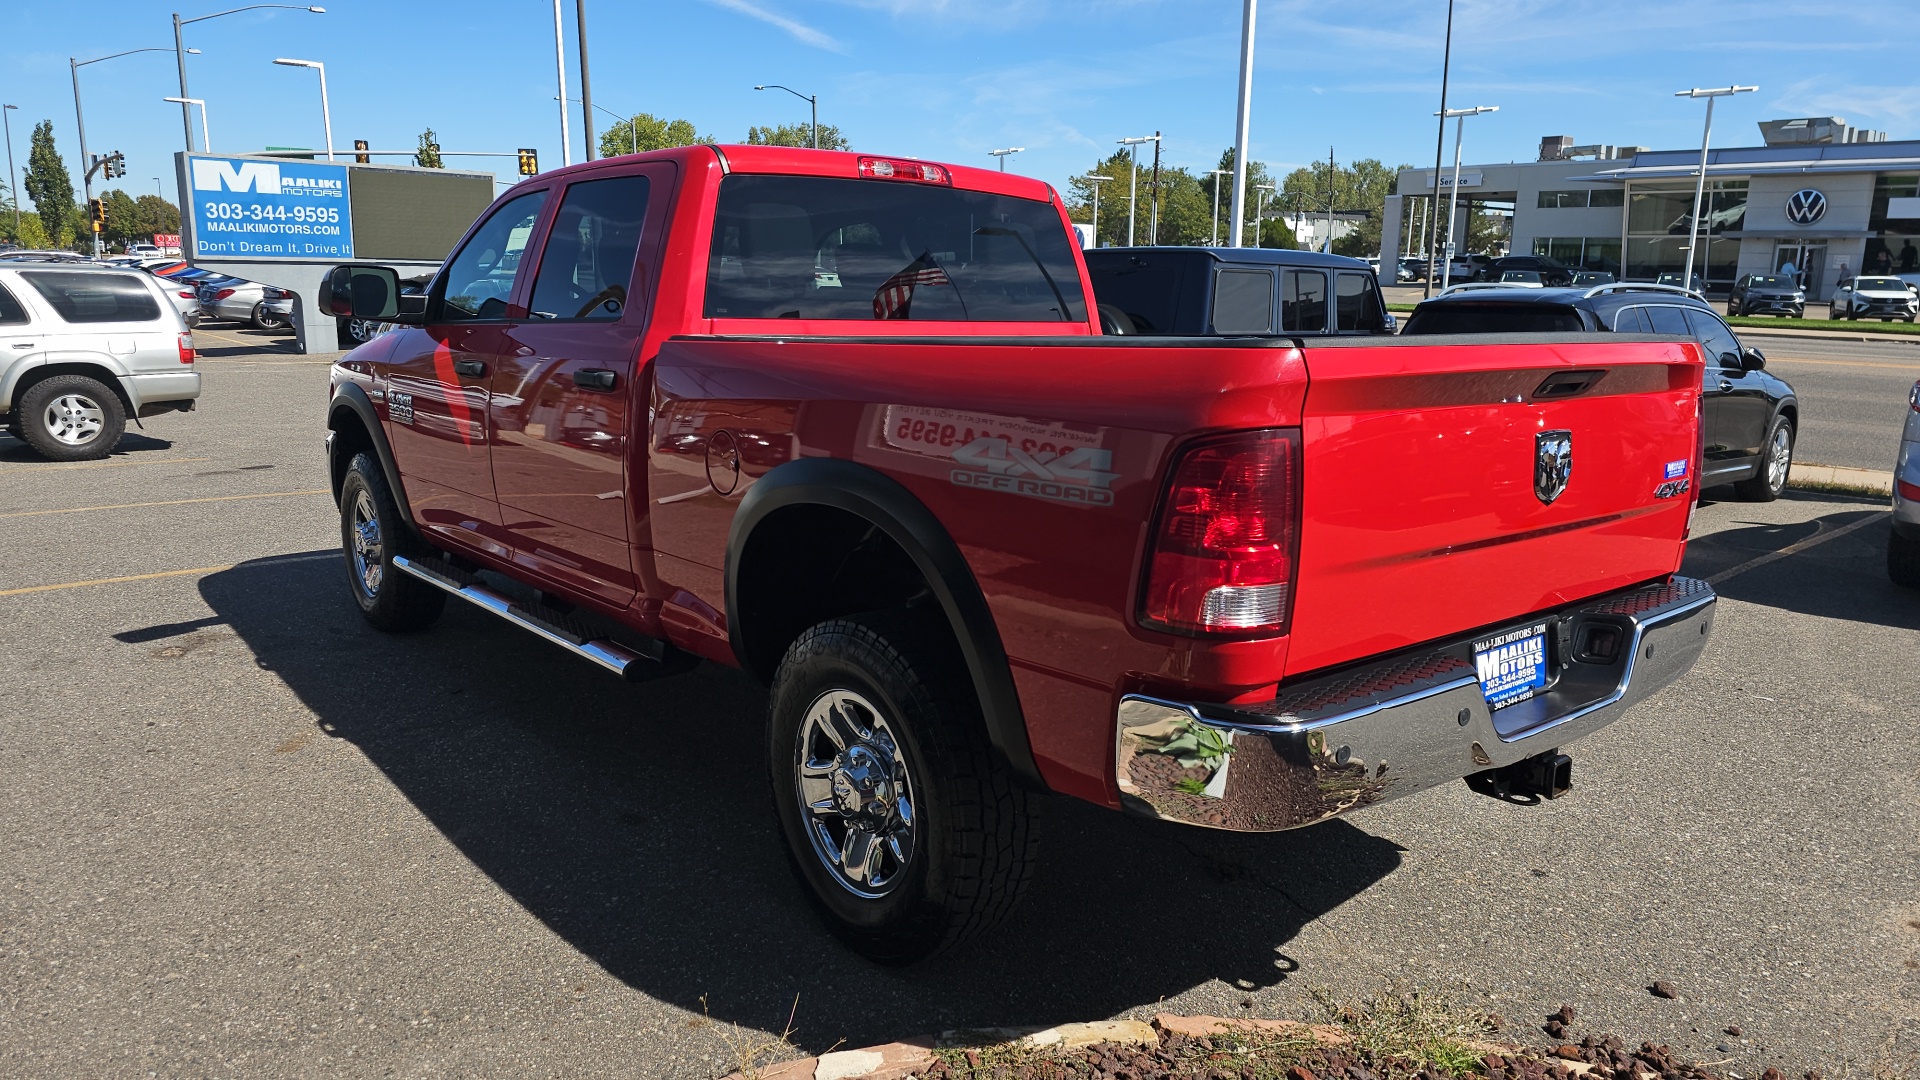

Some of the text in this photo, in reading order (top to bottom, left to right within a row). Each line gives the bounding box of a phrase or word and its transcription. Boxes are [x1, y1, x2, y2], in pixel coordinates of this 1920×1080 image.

[1440, 177, 1468, 186] Serice
[282, 187, 342, 198] MOTORS
[205, 202, 339, 223] 303-344-9595
[207, 221, 340, 236] MAALIKIMOTORS.COM
[199, 240, 235, 252] Don't
[240, 241, 283, 253] Dream
[305, 243, 338, 254] Drive
[342, 244, 350, 254] It
[953, 472, 1113, 504] OFF ROAD
[1505, 627, 1532, 644] MOTORS
[1485, 665, 1536, 690] 303-344-9595
